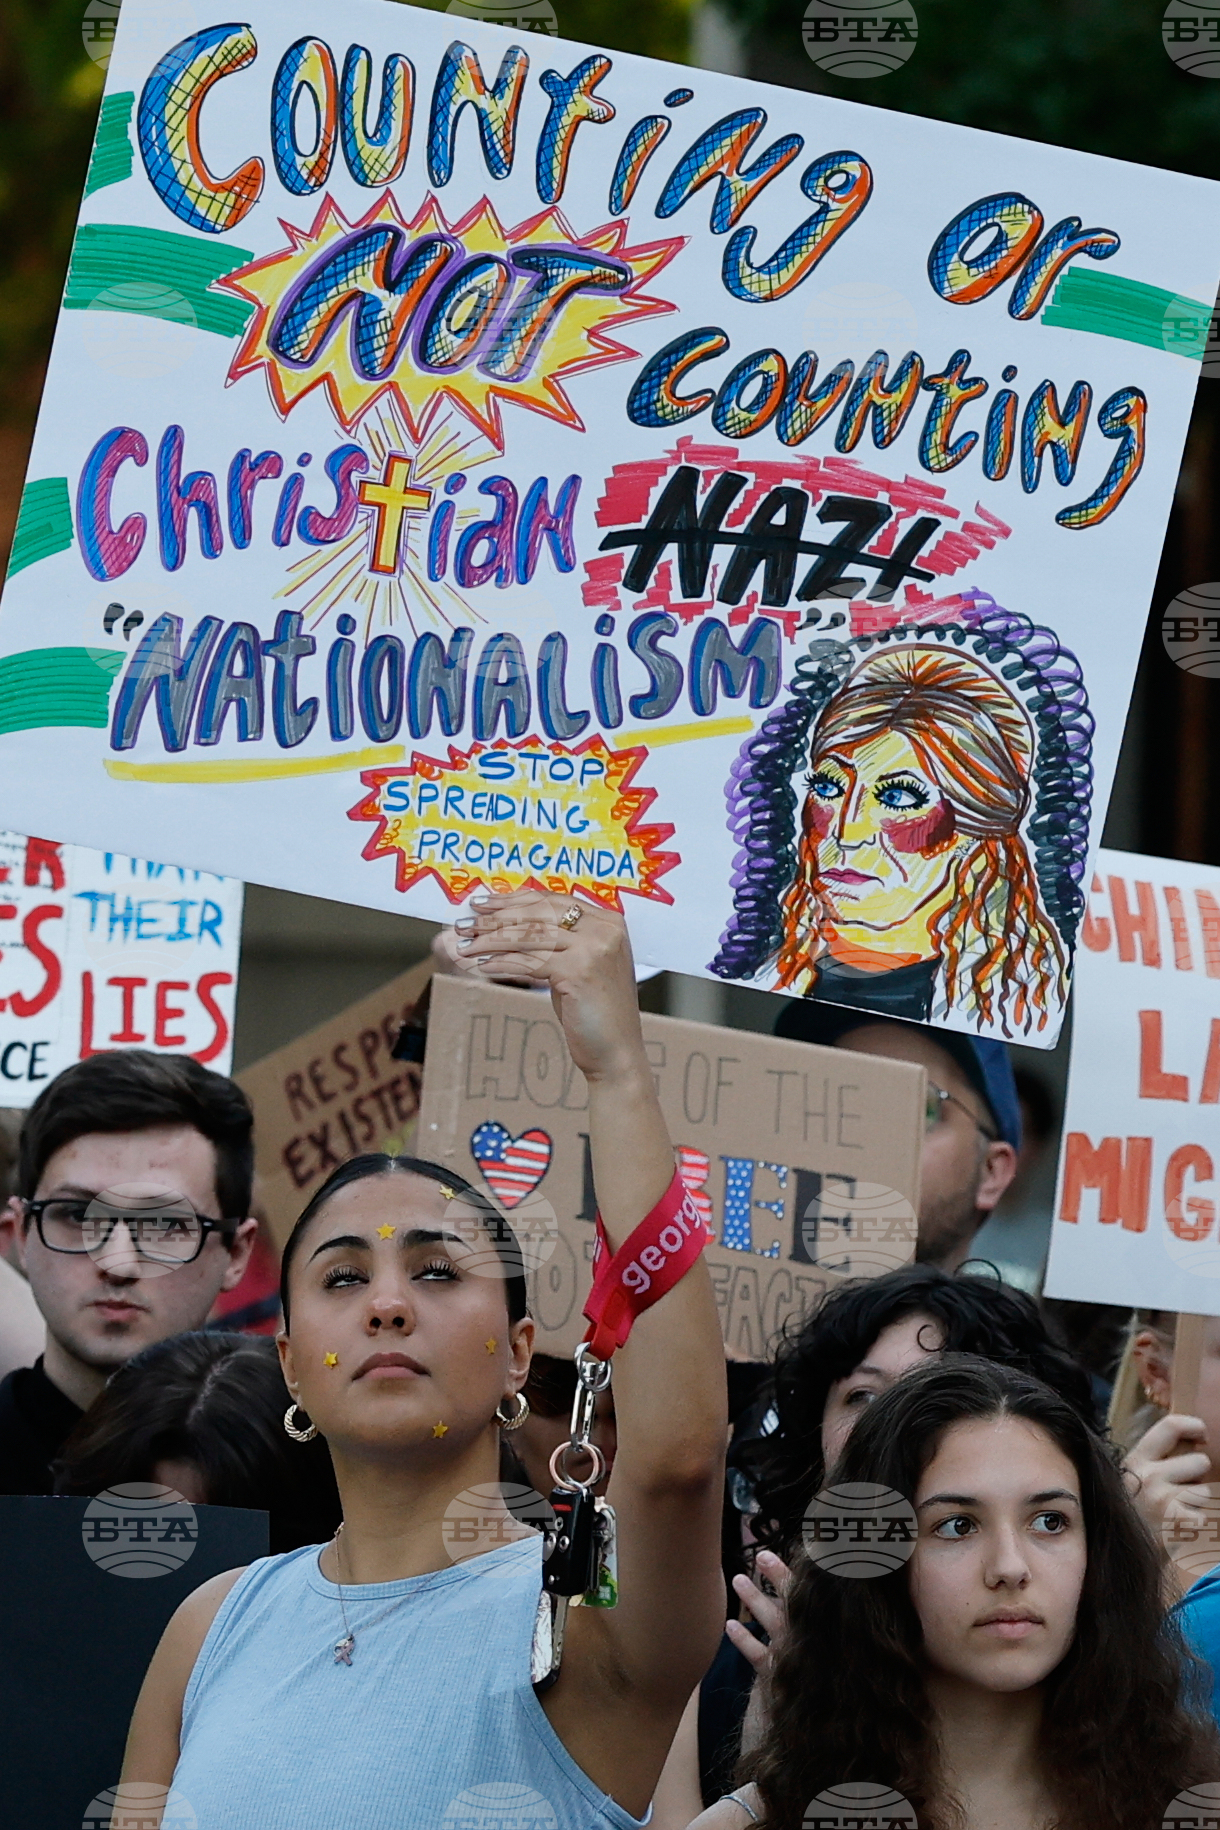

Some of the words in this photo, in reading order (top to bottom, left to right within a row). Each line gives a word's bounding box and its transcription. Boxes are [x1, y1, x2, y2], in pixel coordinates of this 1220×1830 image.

[268, 223, 632, 381] NOT
[478, 751, 605, 786] STOP
[383, 780, 590, 834] SPREADING
[418, 829, 635, 879] PROPAGANDA
[71, 890, 224, 948] THEIR
[79, 970, 233, 1064] LIES
[684, 1050, 740, 1126] OF
[767, 1069, 864, 1151] THE
